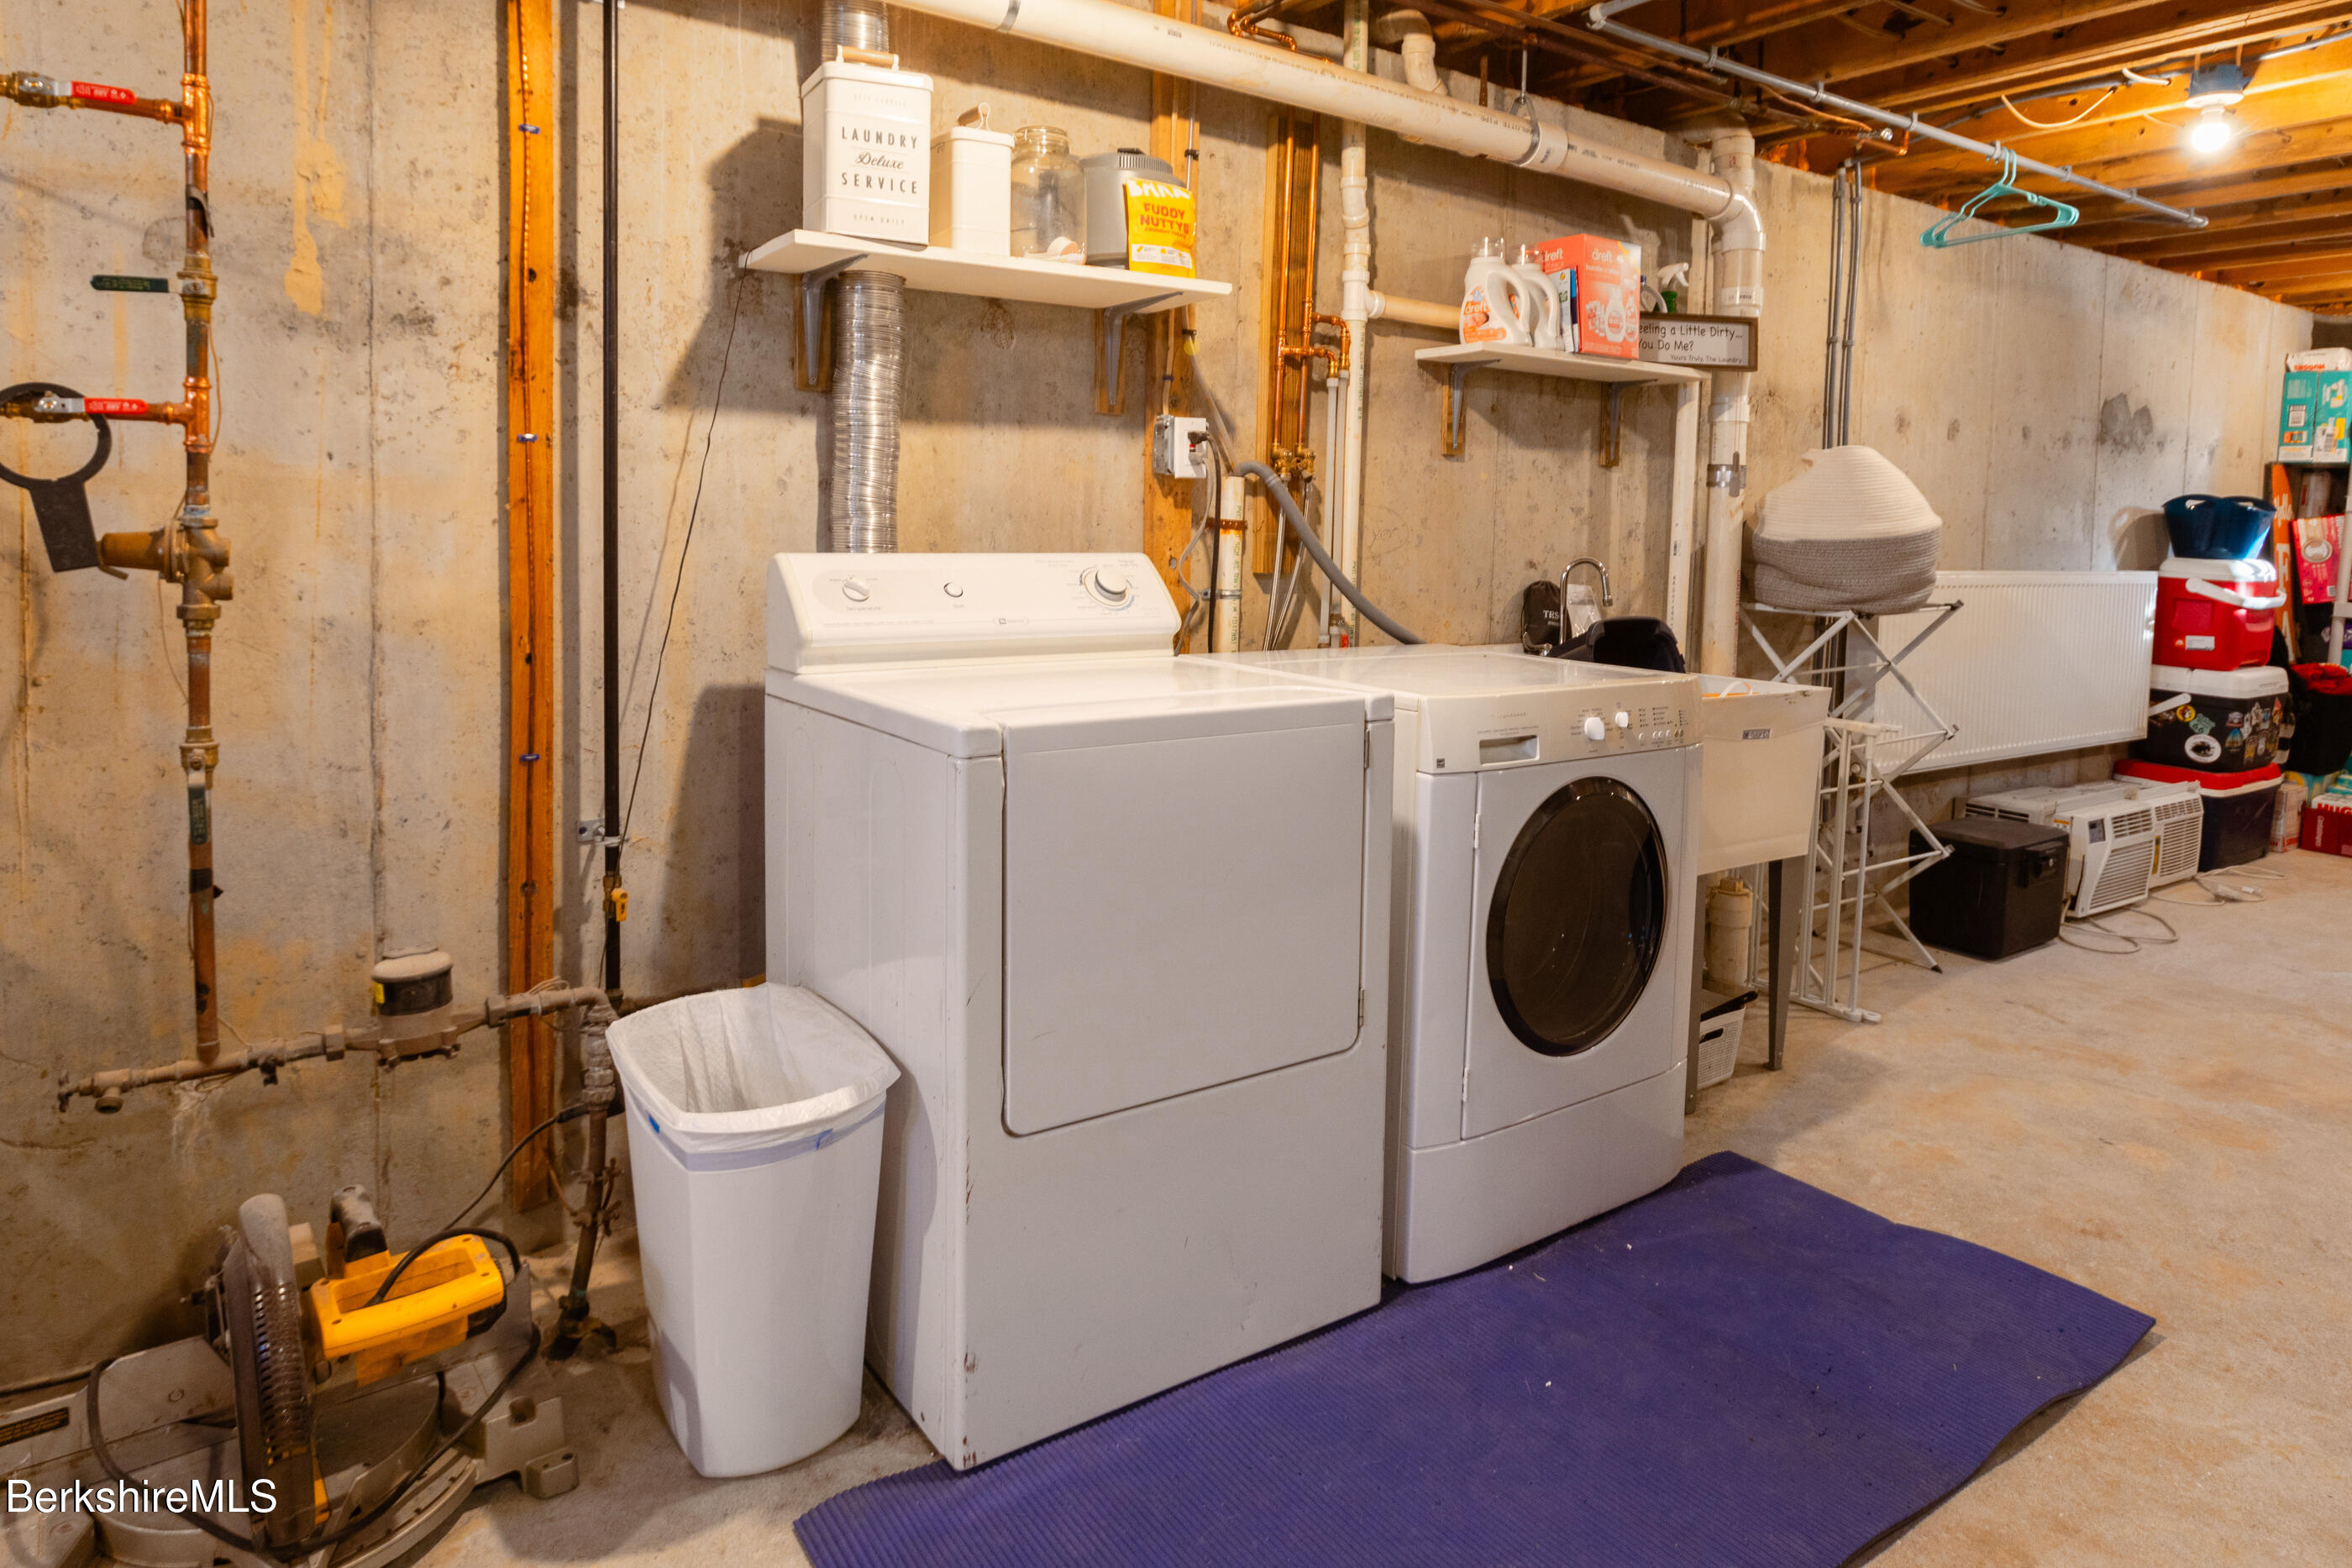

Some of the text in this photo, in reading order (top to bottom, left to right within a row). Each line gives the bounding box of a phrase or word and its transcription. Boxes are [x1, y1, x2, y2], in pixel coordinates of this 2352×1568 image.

[842, 126, 917, 149] LAUNDRY
[856, 151, 904, 170] Deluxe
[842, 172, 917, 194] SERVICE
[1140, 215, 1189, 234] NUTTYS
[1592, 248, 1613, 263] dreft
[1466, 302, 1487, 314] dreft
[1639, 324, 1666, 338] eeling
[1670, 326, 1676, 335] a
[1680, 325, 1706, 337] Little
[1657, 339, 1670, 350] Do
[1674, 340, 1693, 351] Me?
